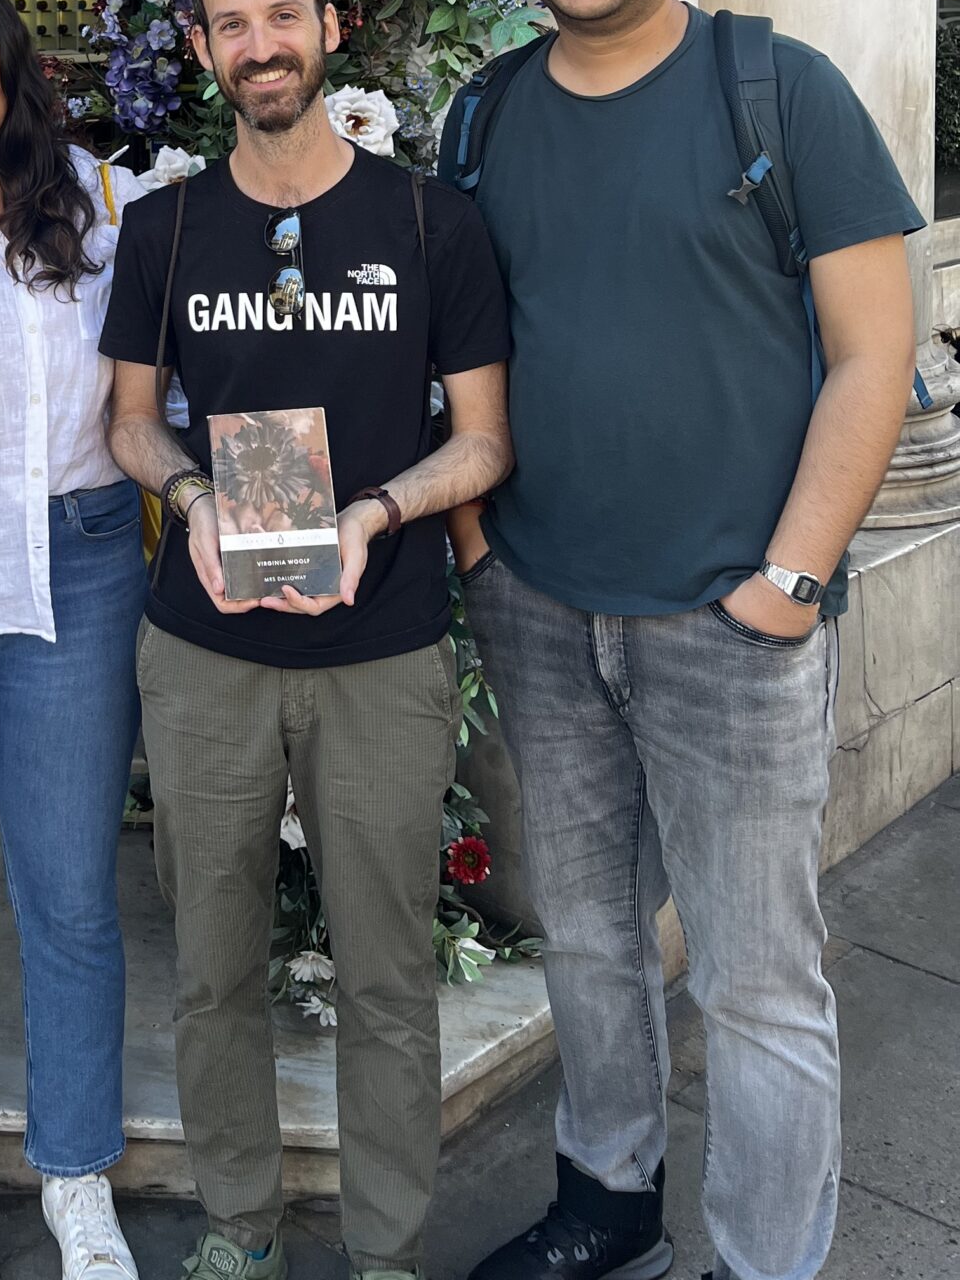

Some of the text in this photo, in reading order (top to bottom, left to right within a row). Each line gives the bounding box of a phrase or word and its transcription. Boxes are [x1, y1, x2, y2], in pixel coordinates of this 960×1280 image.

[361, 263, 380, 271] THE
[347, 270, 380, 278] NORTH
[356, 277, 380, 285] FACE
[211, 1250, 236, 1272] DUDE
